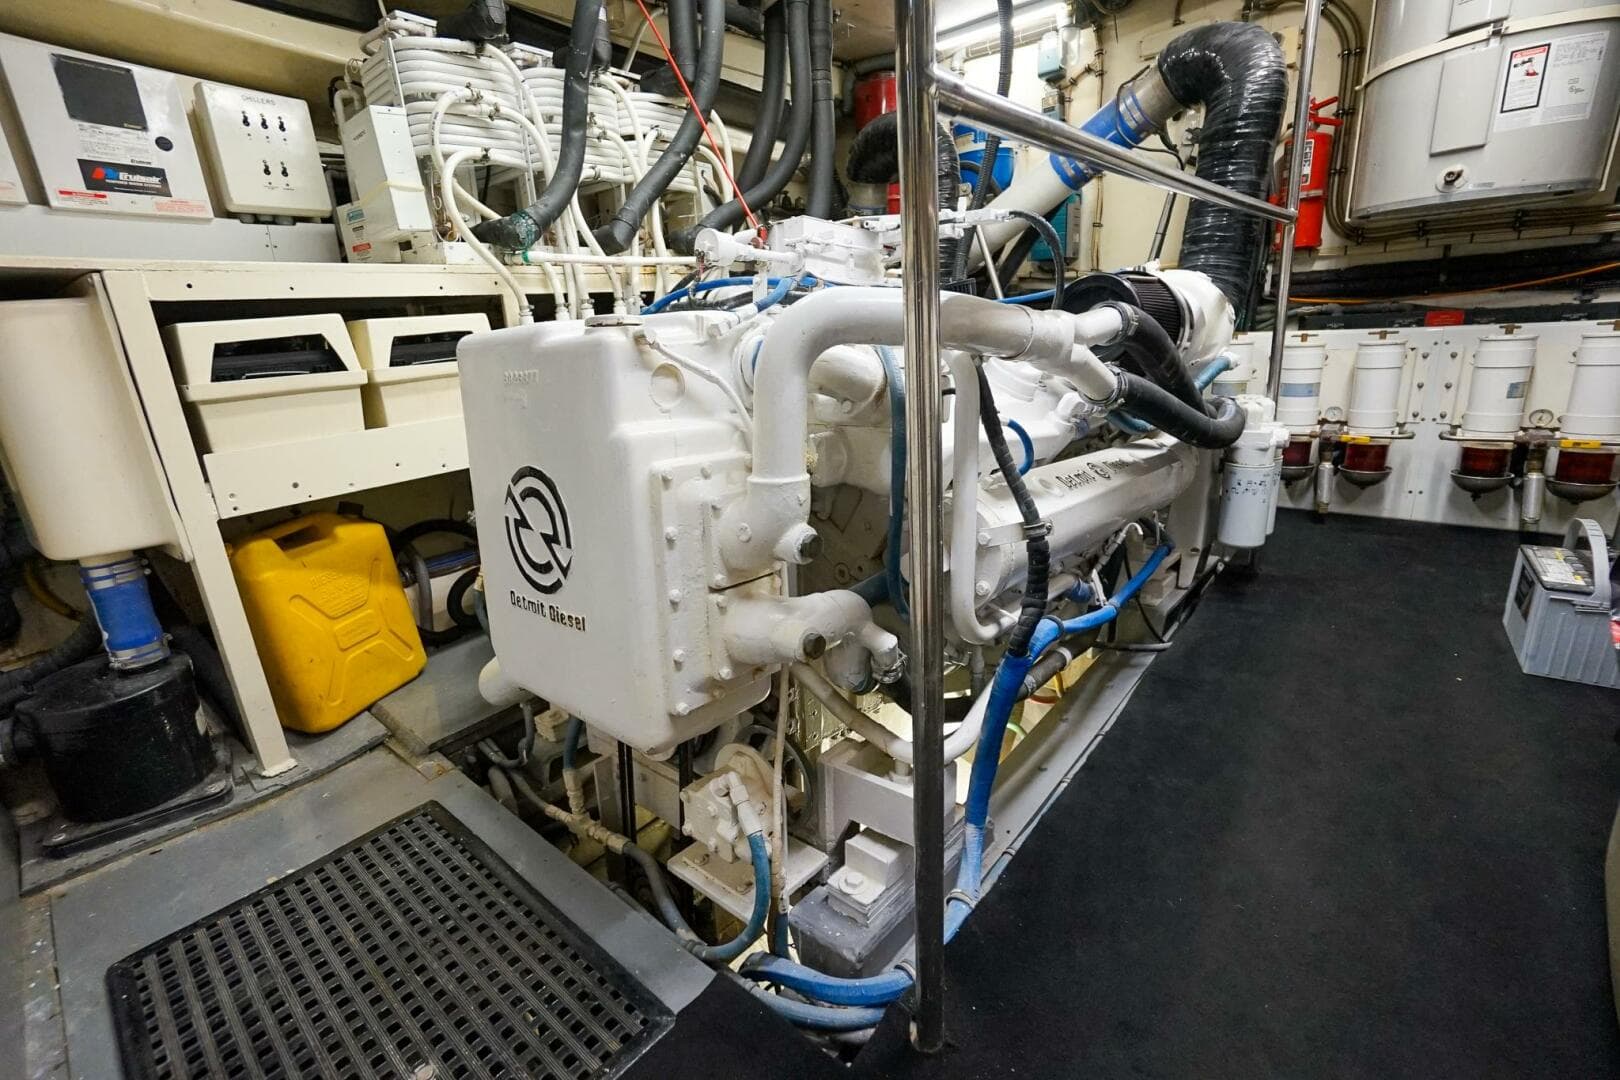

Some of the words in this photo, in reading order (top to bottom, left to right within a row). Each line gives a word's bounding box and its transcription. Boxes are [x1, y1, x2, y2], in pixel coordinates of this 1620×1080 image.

[241, 94, 276, 106] CHILLERS
[510, 590, 547, 618] Detroit
[549, 604, 586, 632] Diesel
